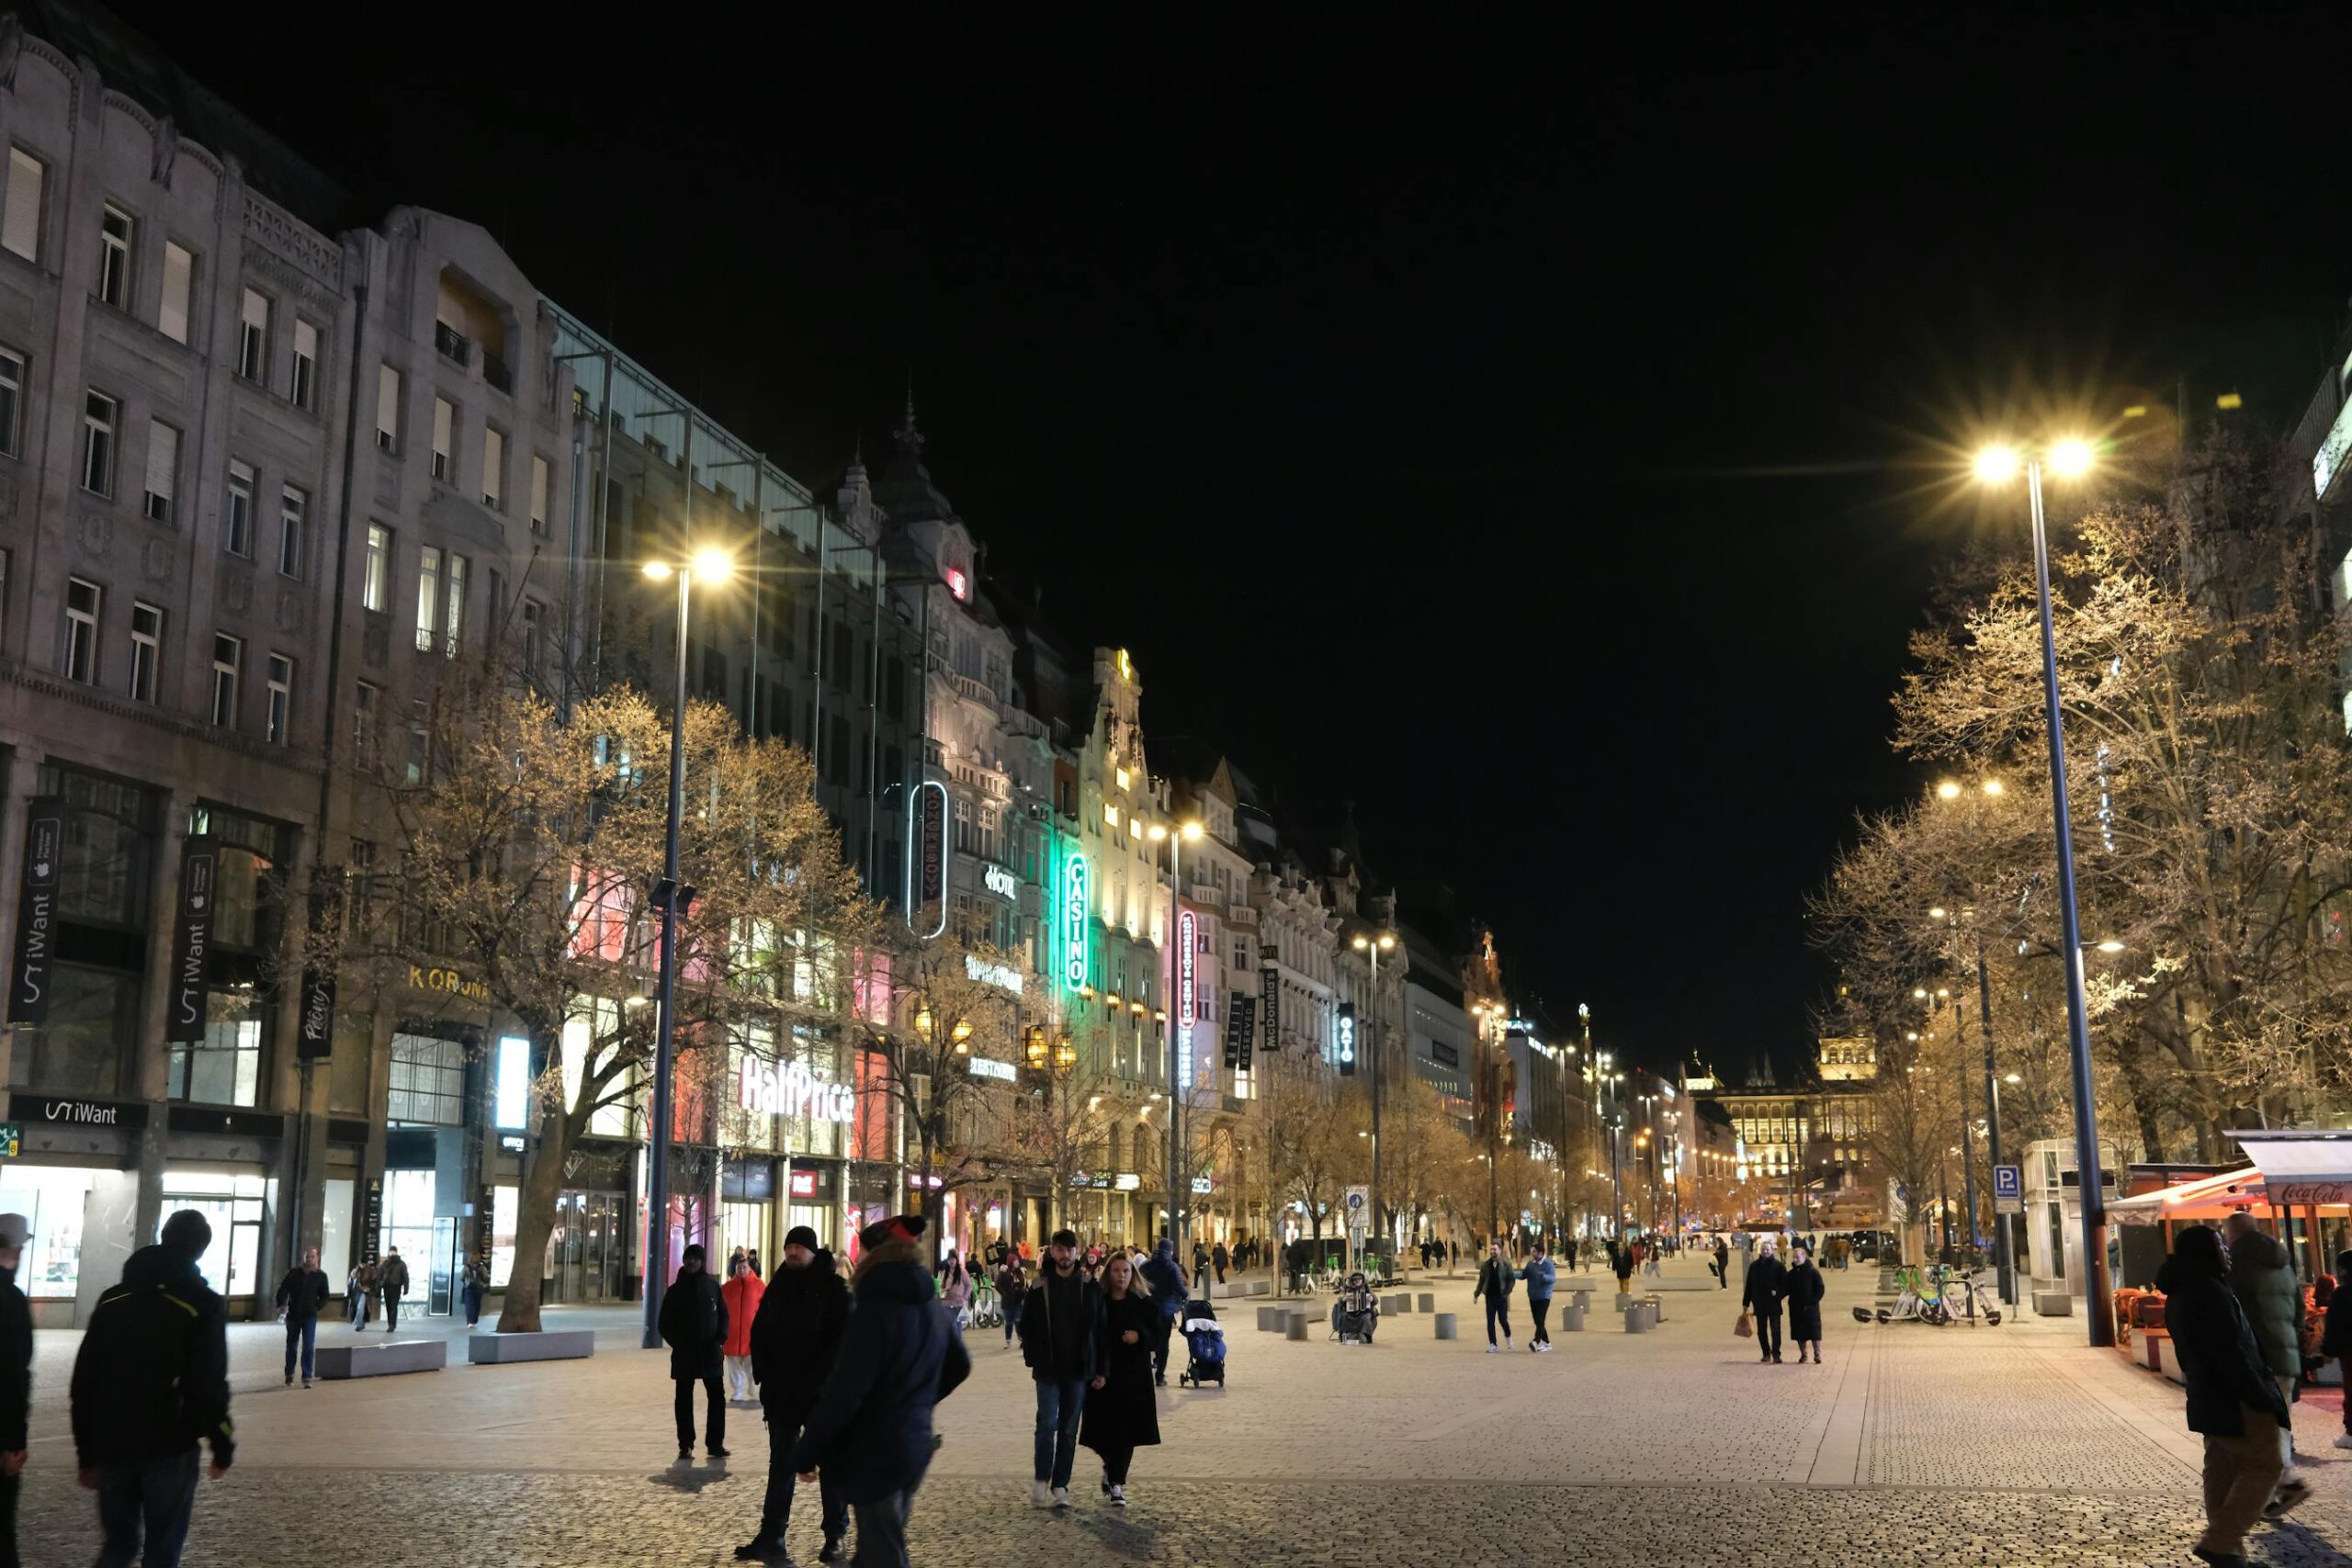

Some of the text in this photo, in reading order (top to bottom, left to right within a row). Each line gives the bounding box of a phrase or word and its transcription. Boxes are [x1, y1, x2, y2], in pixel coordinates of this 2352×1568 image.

[26, 894, 50, 958] iWant
[1070, 863, 1084, 980] CASINO
[184, 923, 204, 983] iWant
[1227, 999, 1242, 1059] MOHITO
[1240, 1007, 1253, 1066] RESERVED
[1266, 972, 1276, 1047] McDonald's
[74, 1102, 117, 1124] iWant
[741, 1054, 854, 1122] HalfPrice
[1999, 1169, 2013, 1189] P
